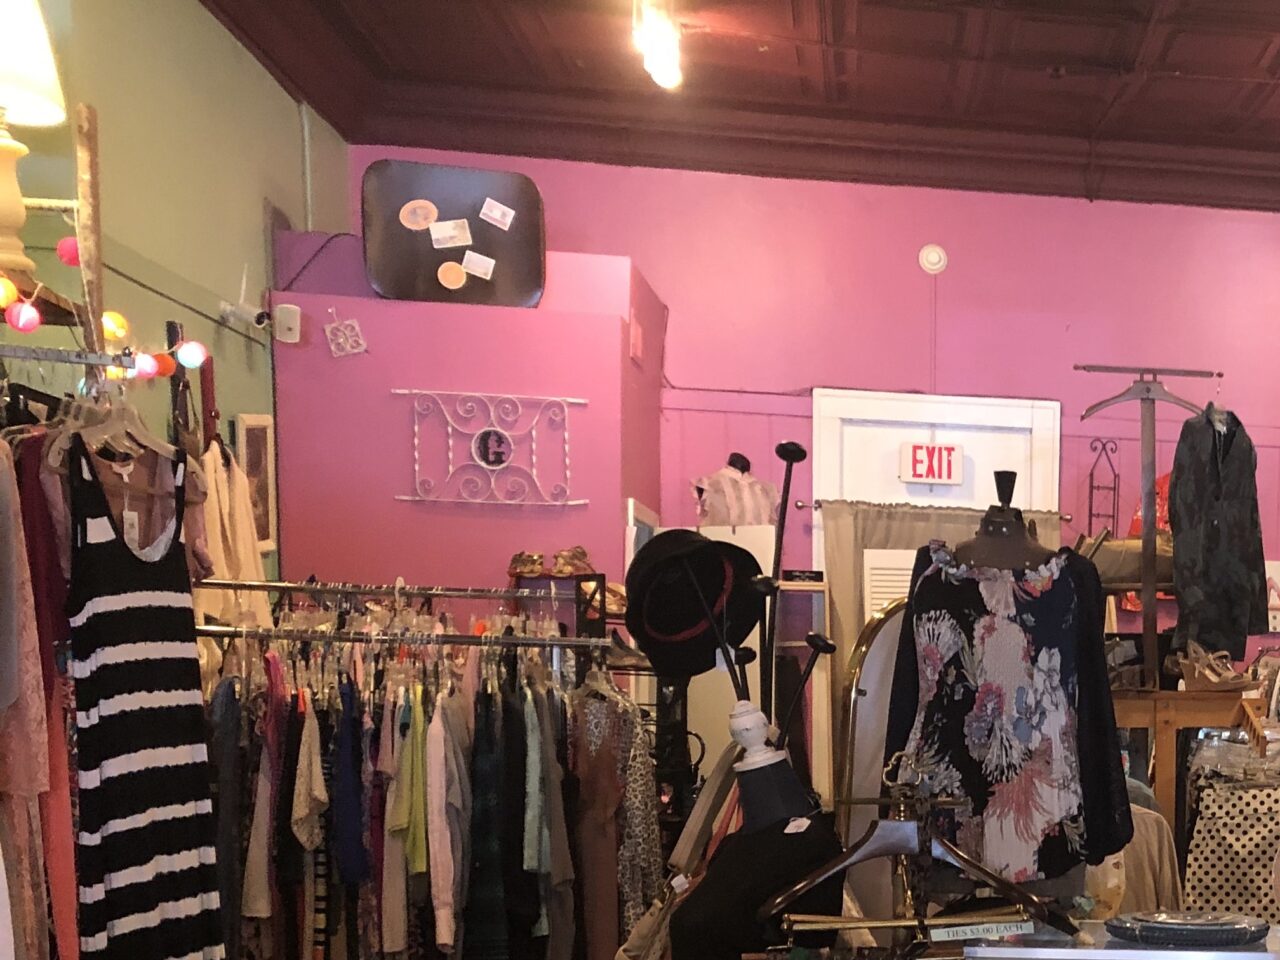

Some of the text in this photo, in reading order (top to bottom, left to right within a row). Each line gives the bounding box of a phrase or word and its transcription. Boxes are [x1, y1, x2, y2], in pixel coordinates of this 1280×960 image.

[911, 445, 955, 480] EXIT
[947, 929, 967, 939] TIES
[995, 923, 1022, 934] EACH
